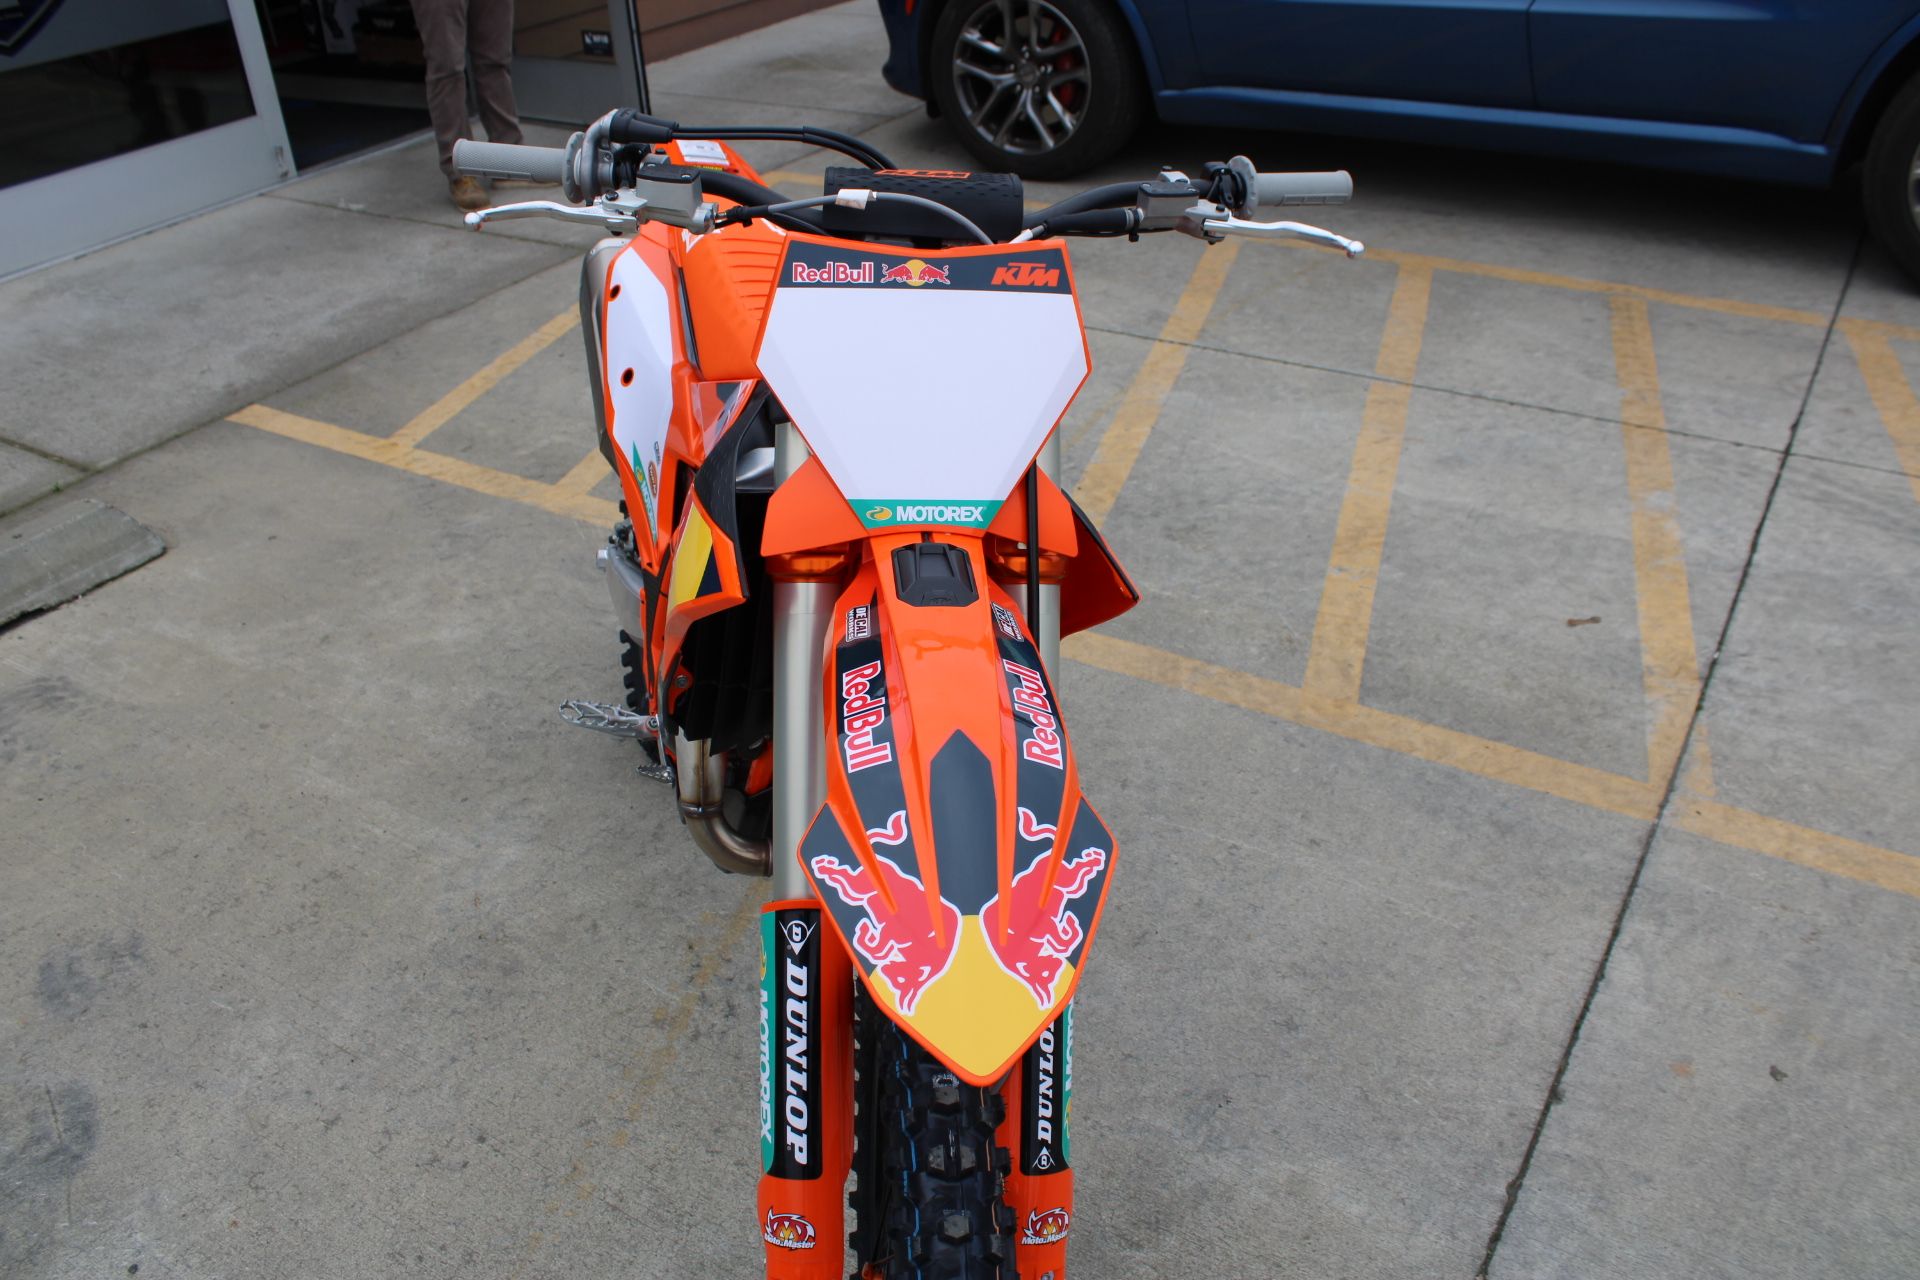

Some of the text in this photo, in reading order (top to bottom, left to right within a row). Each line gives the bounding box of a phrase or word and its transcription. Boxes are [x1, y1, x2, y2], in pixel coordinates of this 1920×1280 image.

[792, 261, 874, 283] Red Bull
[990, 262, 1060, 287] KTM
[896, 506, 983, 522] MOTOREX
[855, 607, 868, 637] DECAL
[842, 660, 892, 773] Red Bull
[1003, 658, 1063, 770] Red Bull
[786, 957, 808, 1165] DUNLOP
